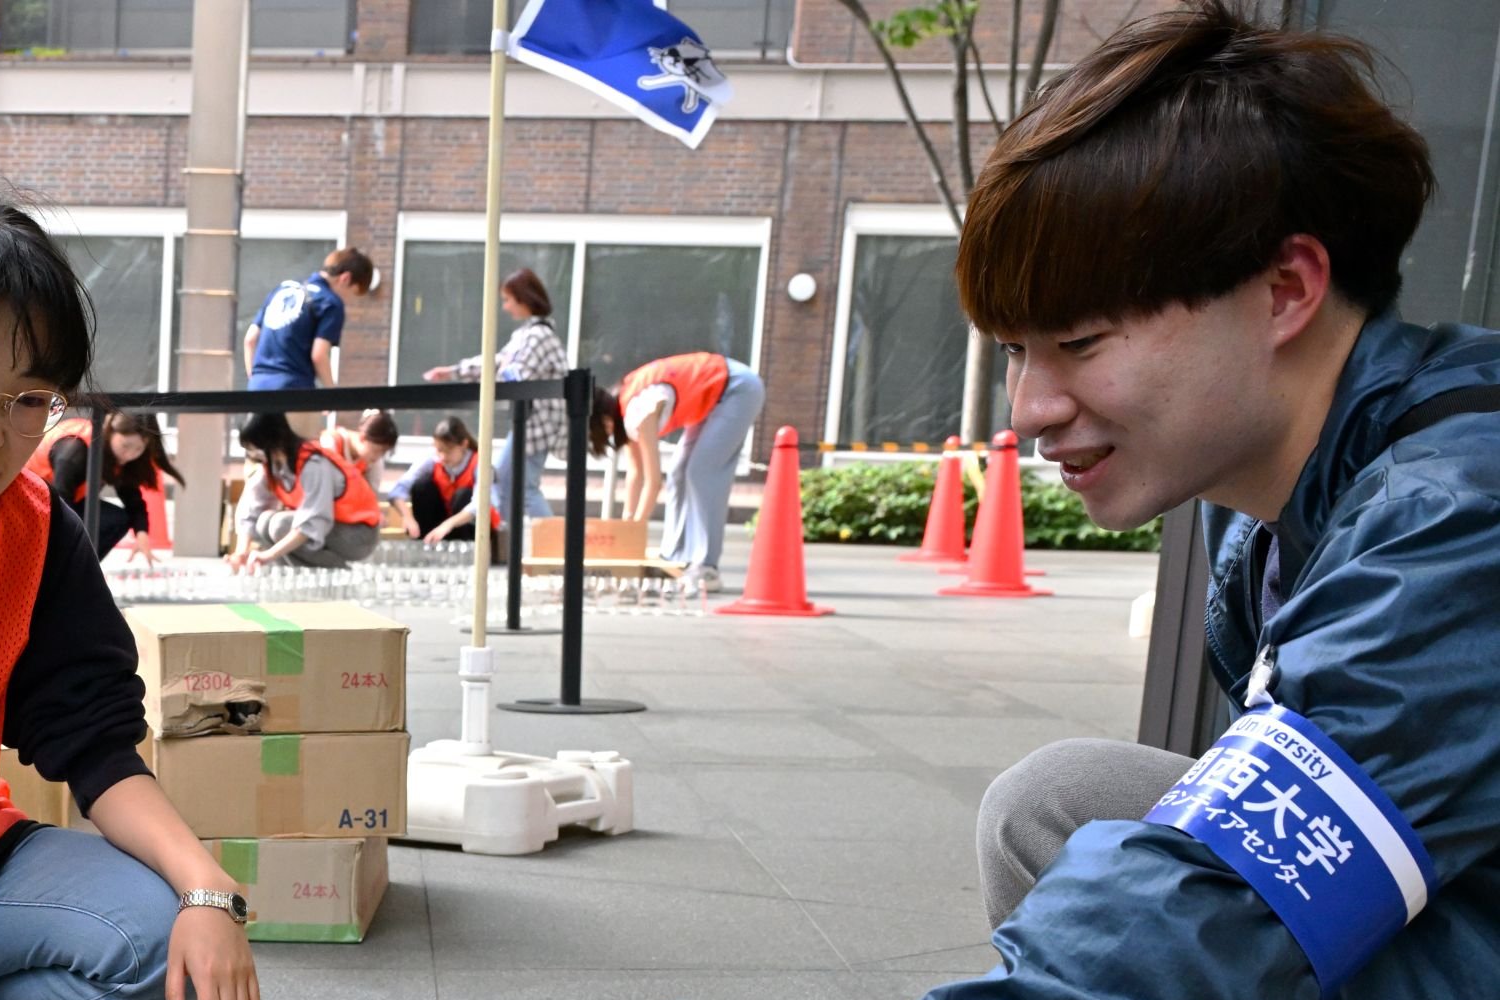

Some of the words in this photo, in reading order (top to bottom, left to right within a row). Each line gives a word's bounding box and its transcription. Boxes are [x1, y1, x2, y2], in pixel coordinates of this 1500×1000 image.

[340, 671, 389, 690] 24本入
[1237, 717, 1332, 780] Unversity
[338, 808, 389, 830] A-31
[1154, 789, 1311, 901] ランティアセンター
[291, 882, 341, 900] 24本入
